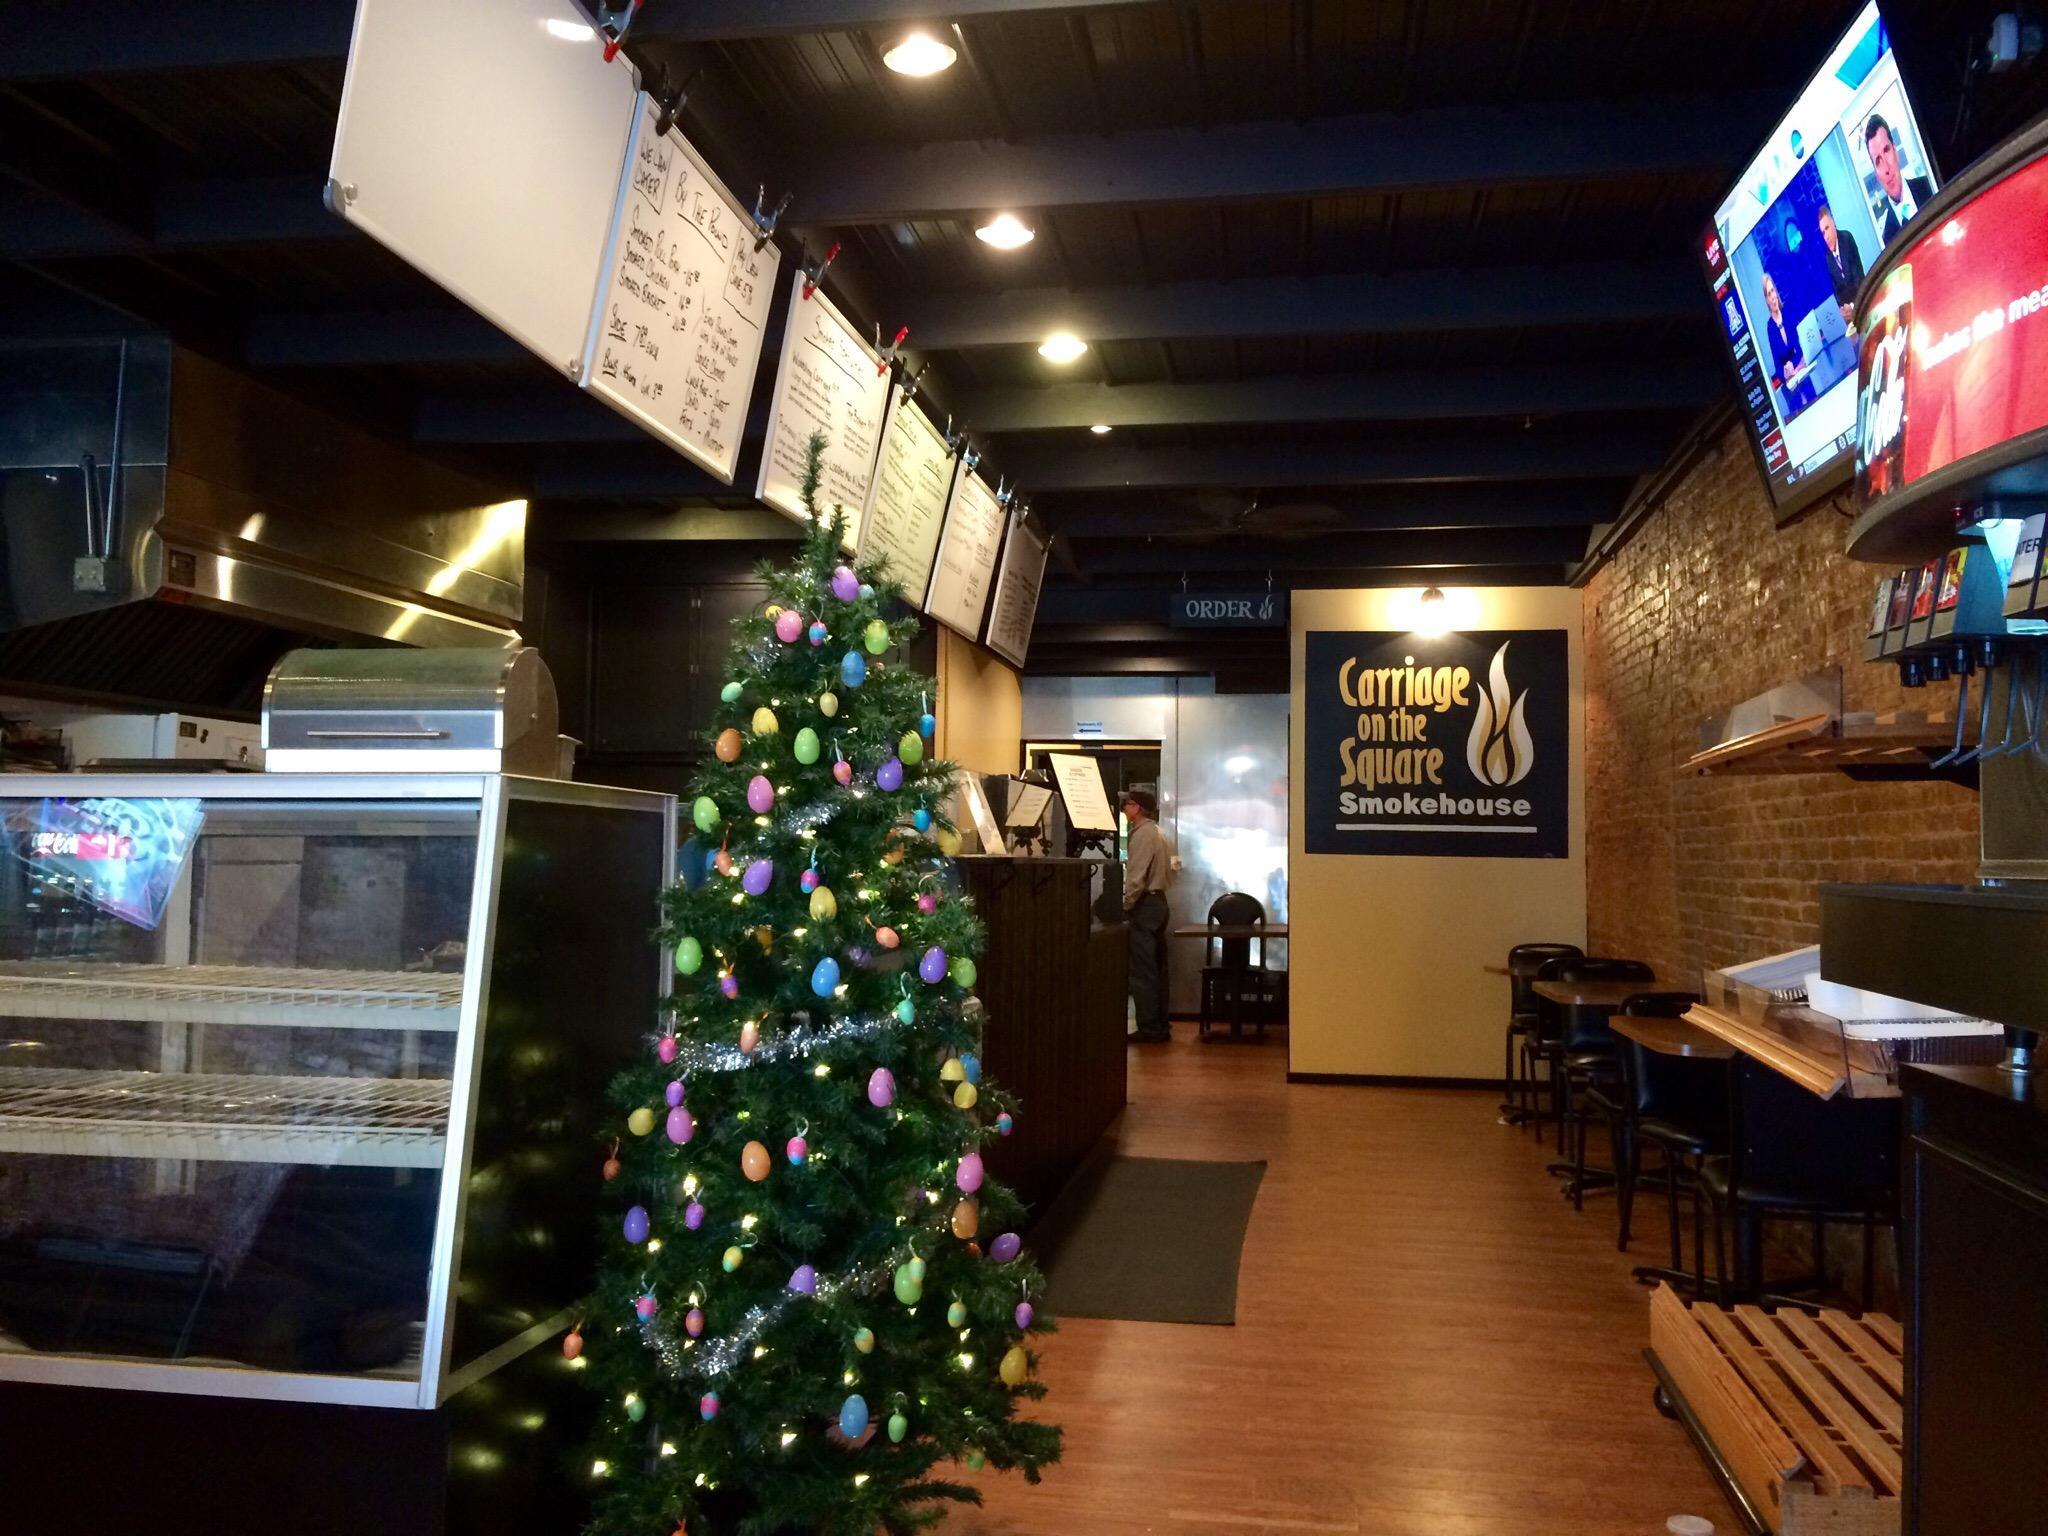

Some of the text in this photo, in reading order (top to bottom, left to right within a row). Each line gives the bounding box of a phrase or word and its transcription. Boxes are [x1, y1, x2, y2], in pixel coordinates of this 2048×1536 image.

[630, 204, 653, 252] SMOKED
[692, 191, 707, 225] THE
[708, 207, 728, 249] POUND
[623, 240, 644, 270] SMOKED
[619, 265, 640, 297] SMOKED
[1185, 600, 1256, 620] ORDER
[1339, 656, 1470, 713] Carriage
[1358, 707, 1427, 742] on the
[1339, 737, 1444, 791] Square
[1339, 792, 1532, 817] Smokehouse
